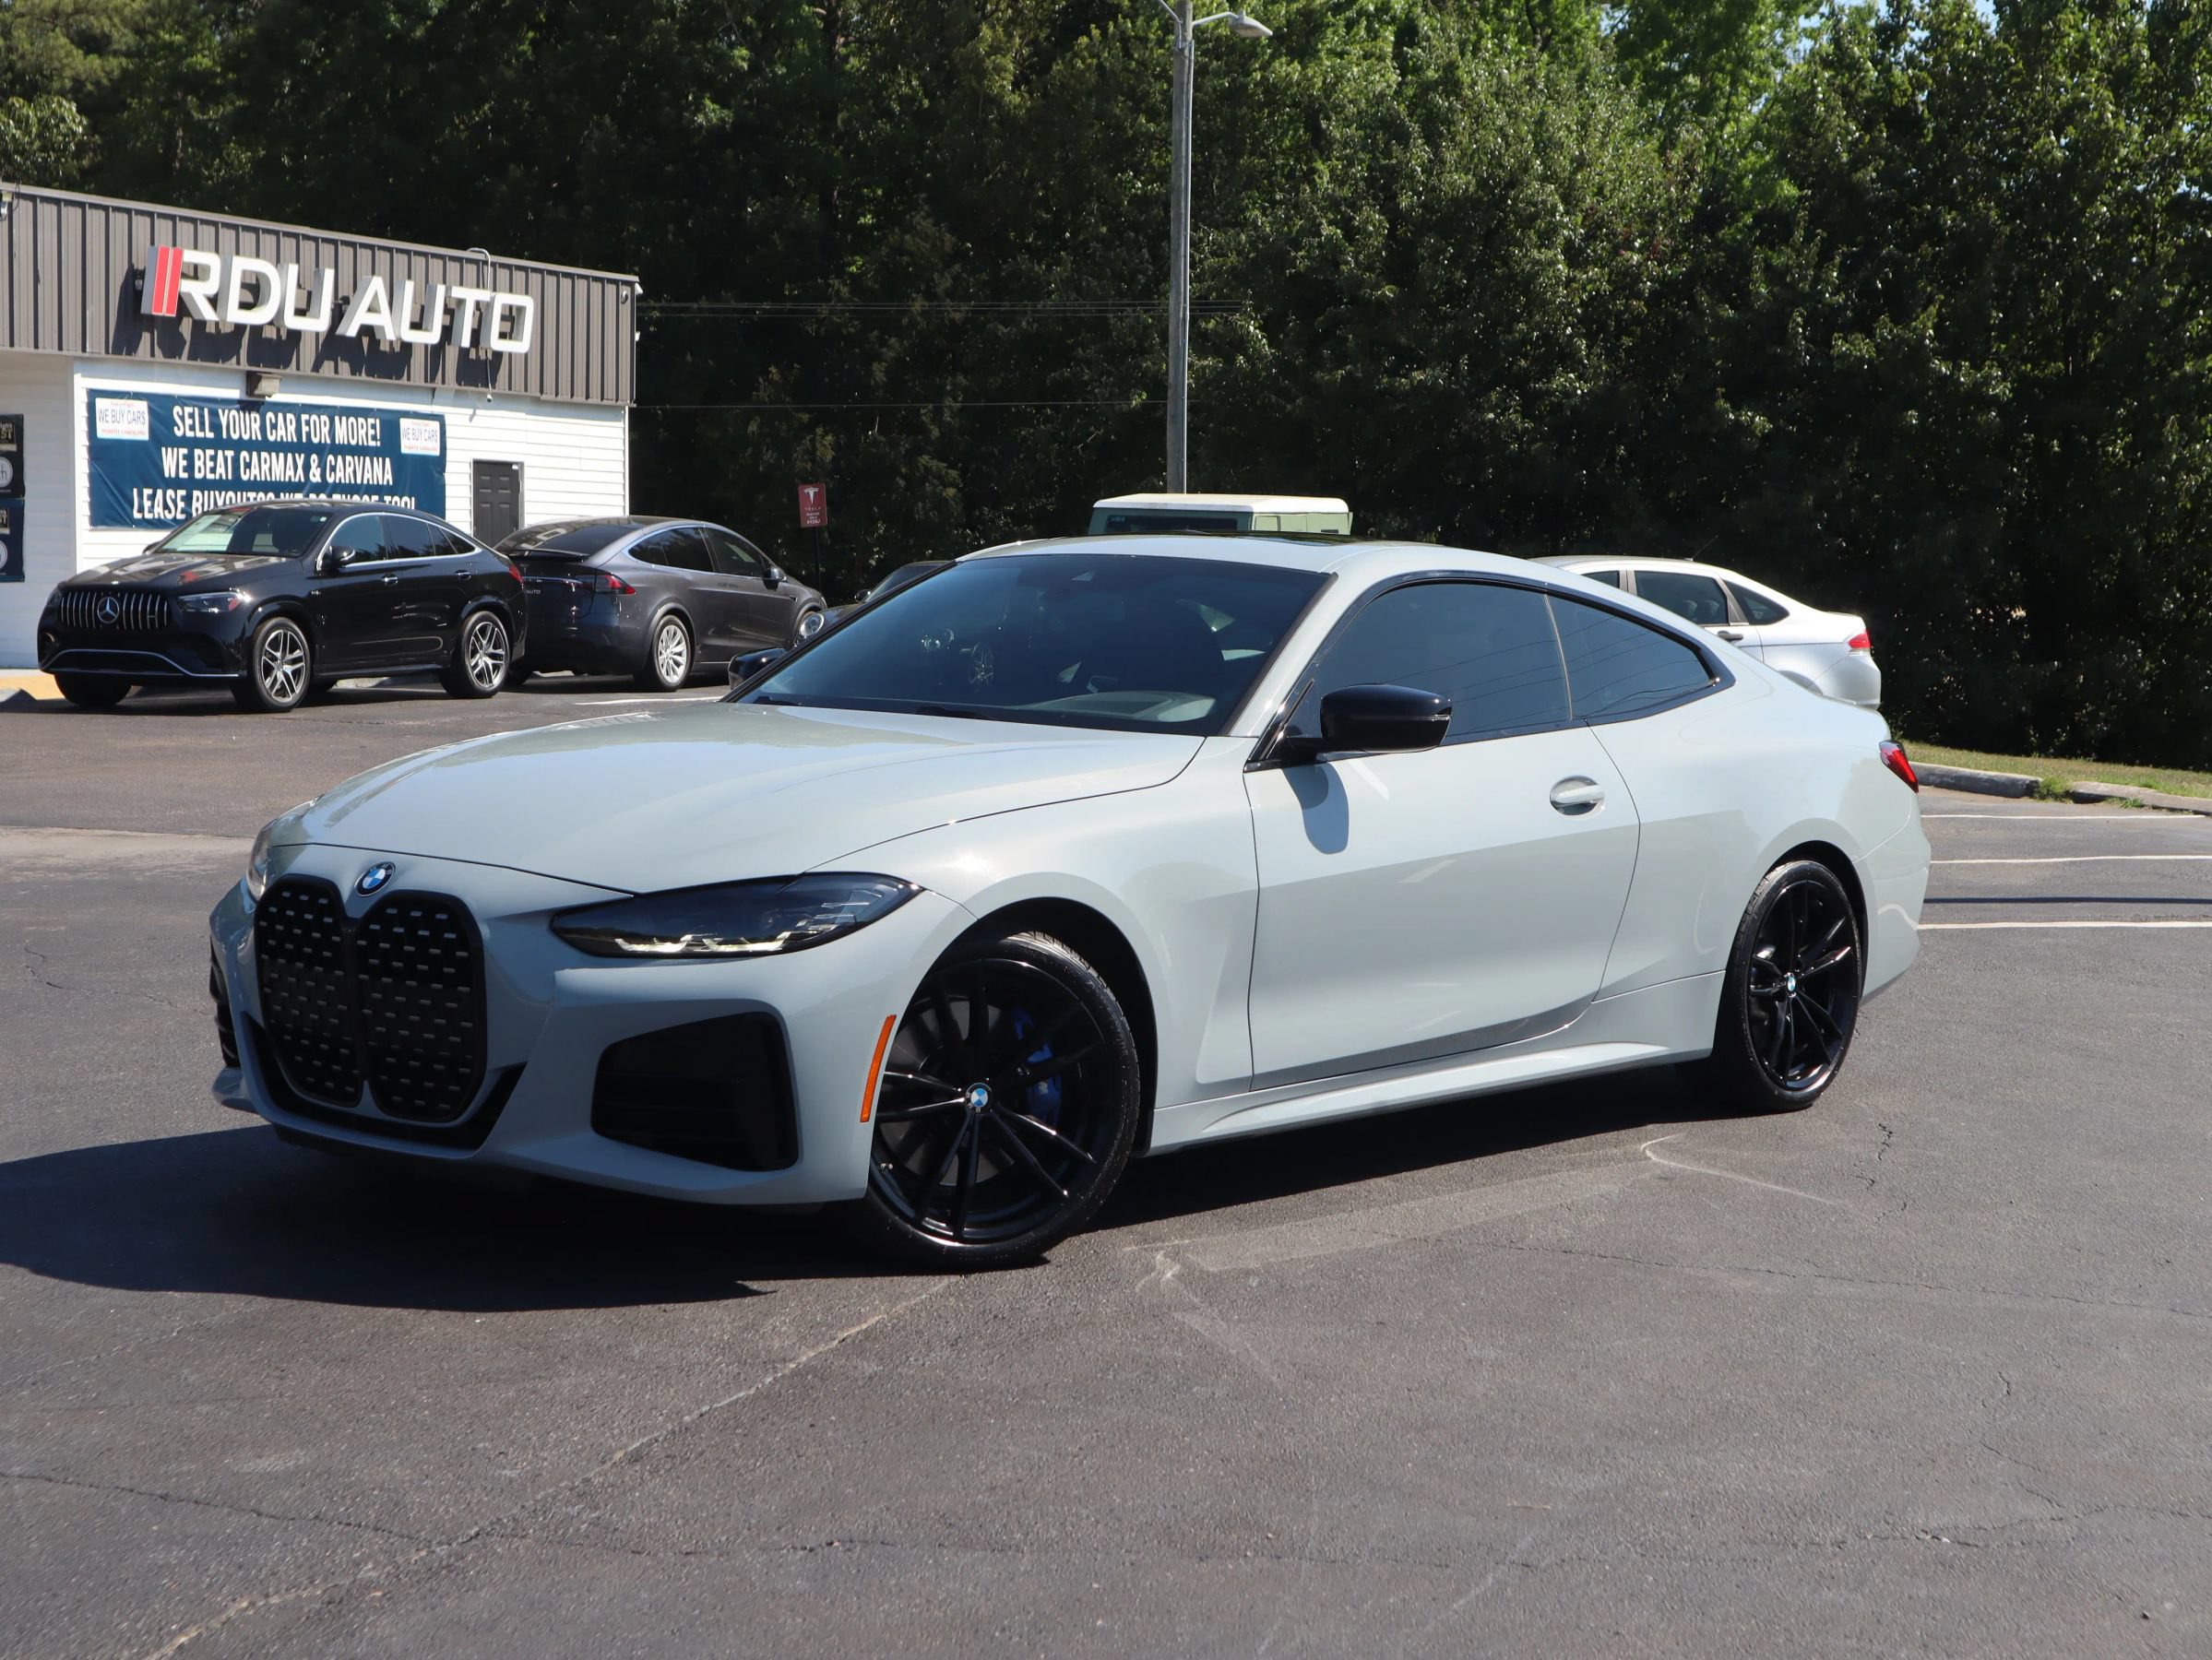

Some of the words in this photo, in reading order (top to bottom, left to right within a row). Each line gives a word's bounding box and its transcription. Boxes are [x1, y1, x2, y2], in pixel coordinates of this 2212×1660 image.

[180, 248, 335, 332] RDU
[345, 275, 534, 354] AUTO
[98, 407, 109, 424] WE
[111, 408, 125, 425] BUY
[172, 405, 215, 438] SELL
[218, 409, 262, 441] YOUR
[266, 411, 298, 443] CAR
[301, 413, 331, 445] FOR
[334, 416, 381, 447] MORE!
[412, 427, 423, 442] BUY
[161, 446, 189, 479] WE
[194, 448, 235, 480] BEAT
[240, 450, 305, 482] CARMAX
[308, 453, 322, 483] &
[326, 454, 394, 486] CARVANA
[132, 487, 187, 519] LEASE
